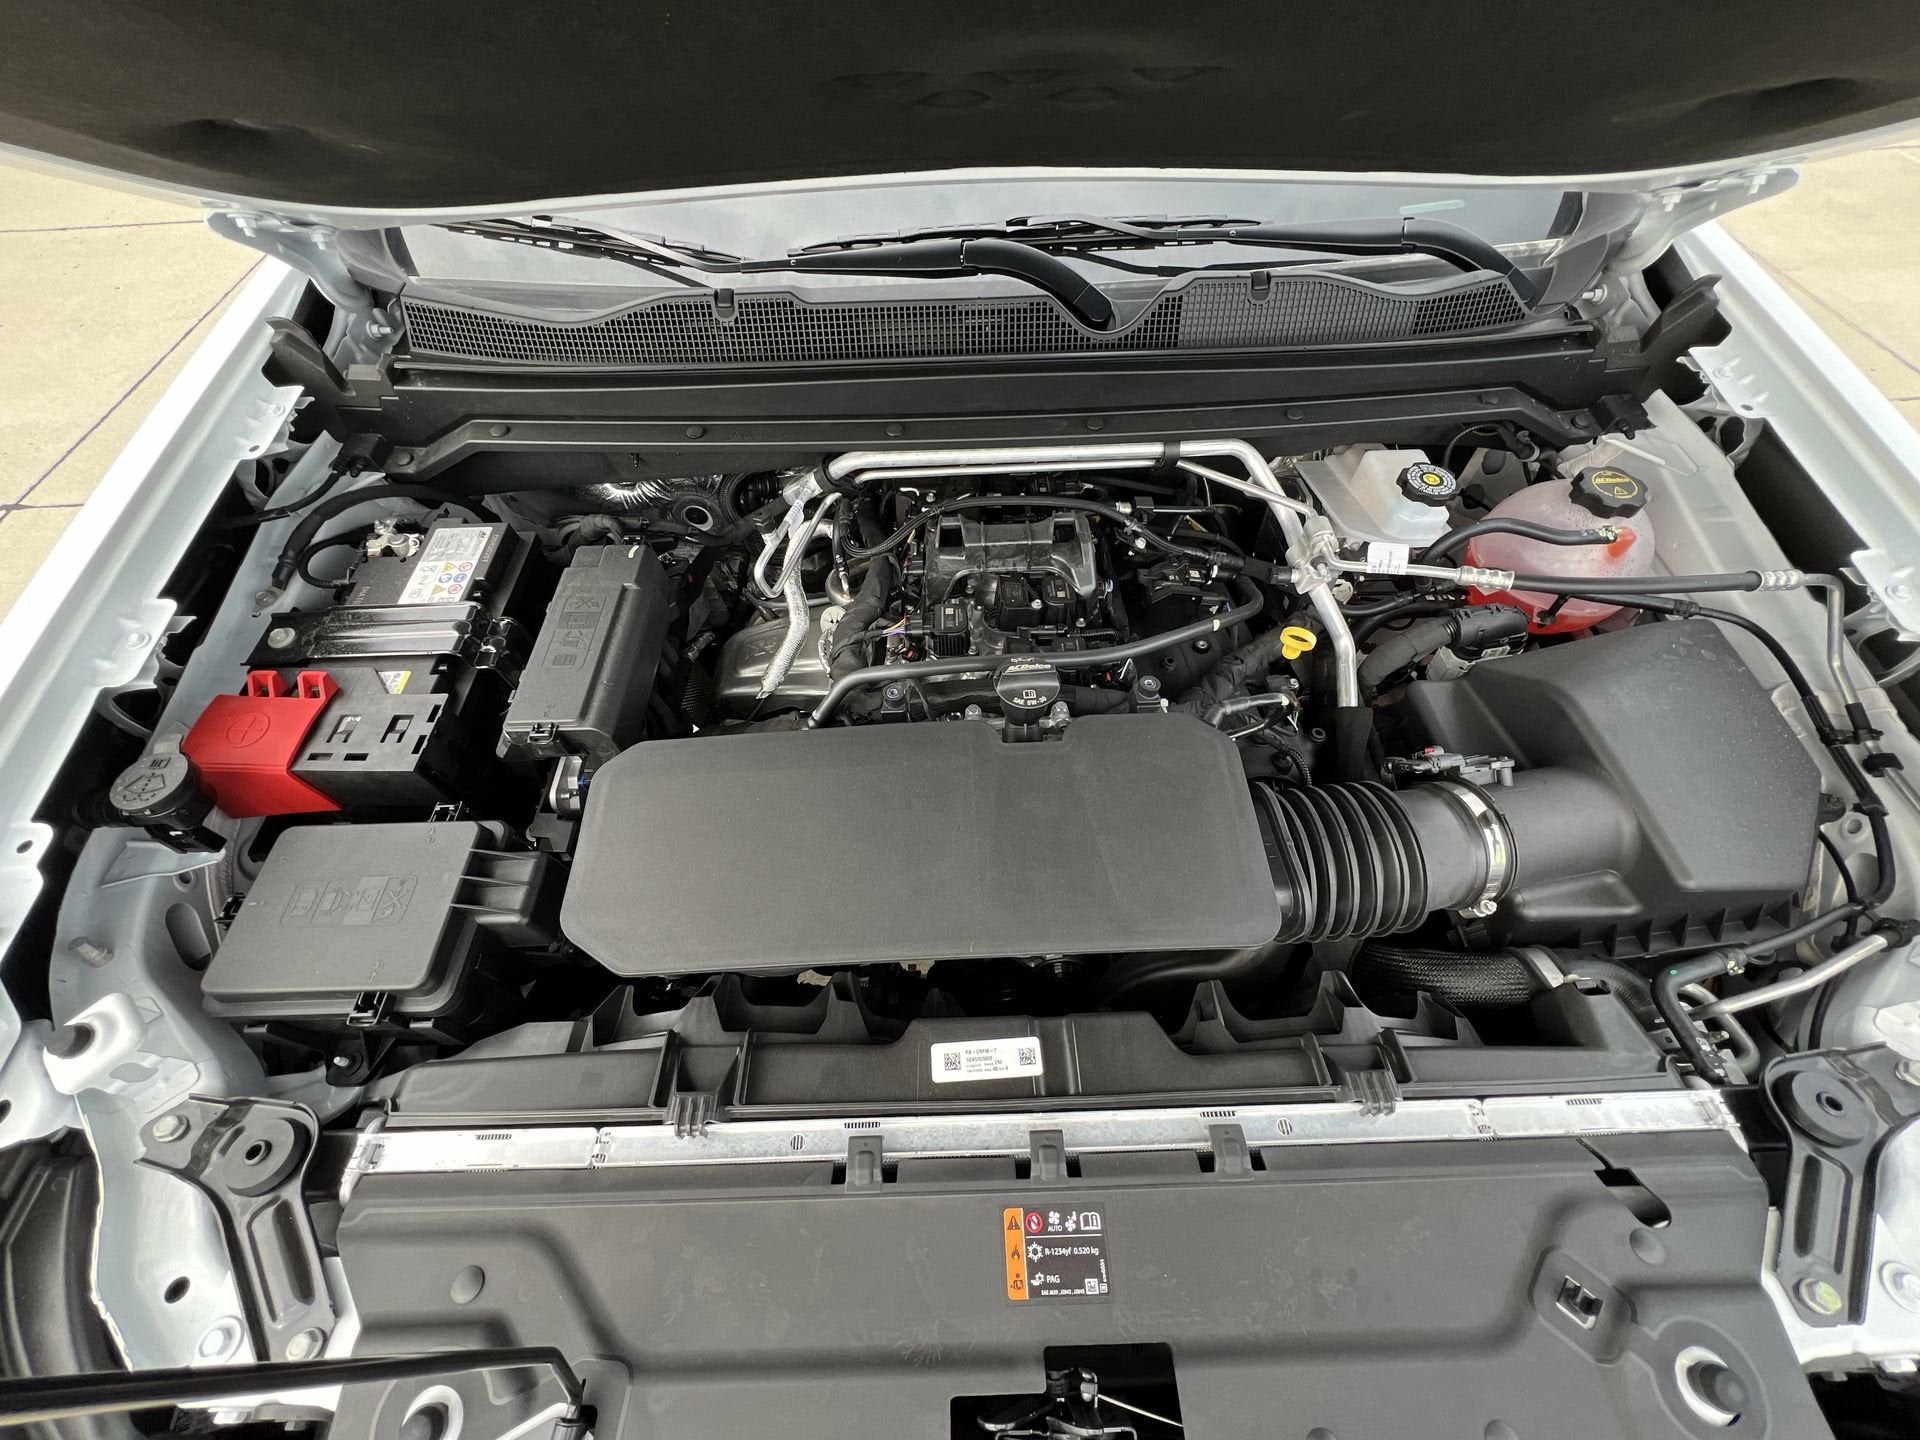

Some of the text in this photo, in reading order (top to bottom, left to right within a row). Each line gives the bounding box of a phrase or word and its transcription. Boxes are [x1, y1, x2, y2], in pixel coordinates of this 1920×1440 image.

[1045, 1246, 1099, 1256] R-1234yf 0.520 kg
[1046, 1275, 1060, 1283] PAG
